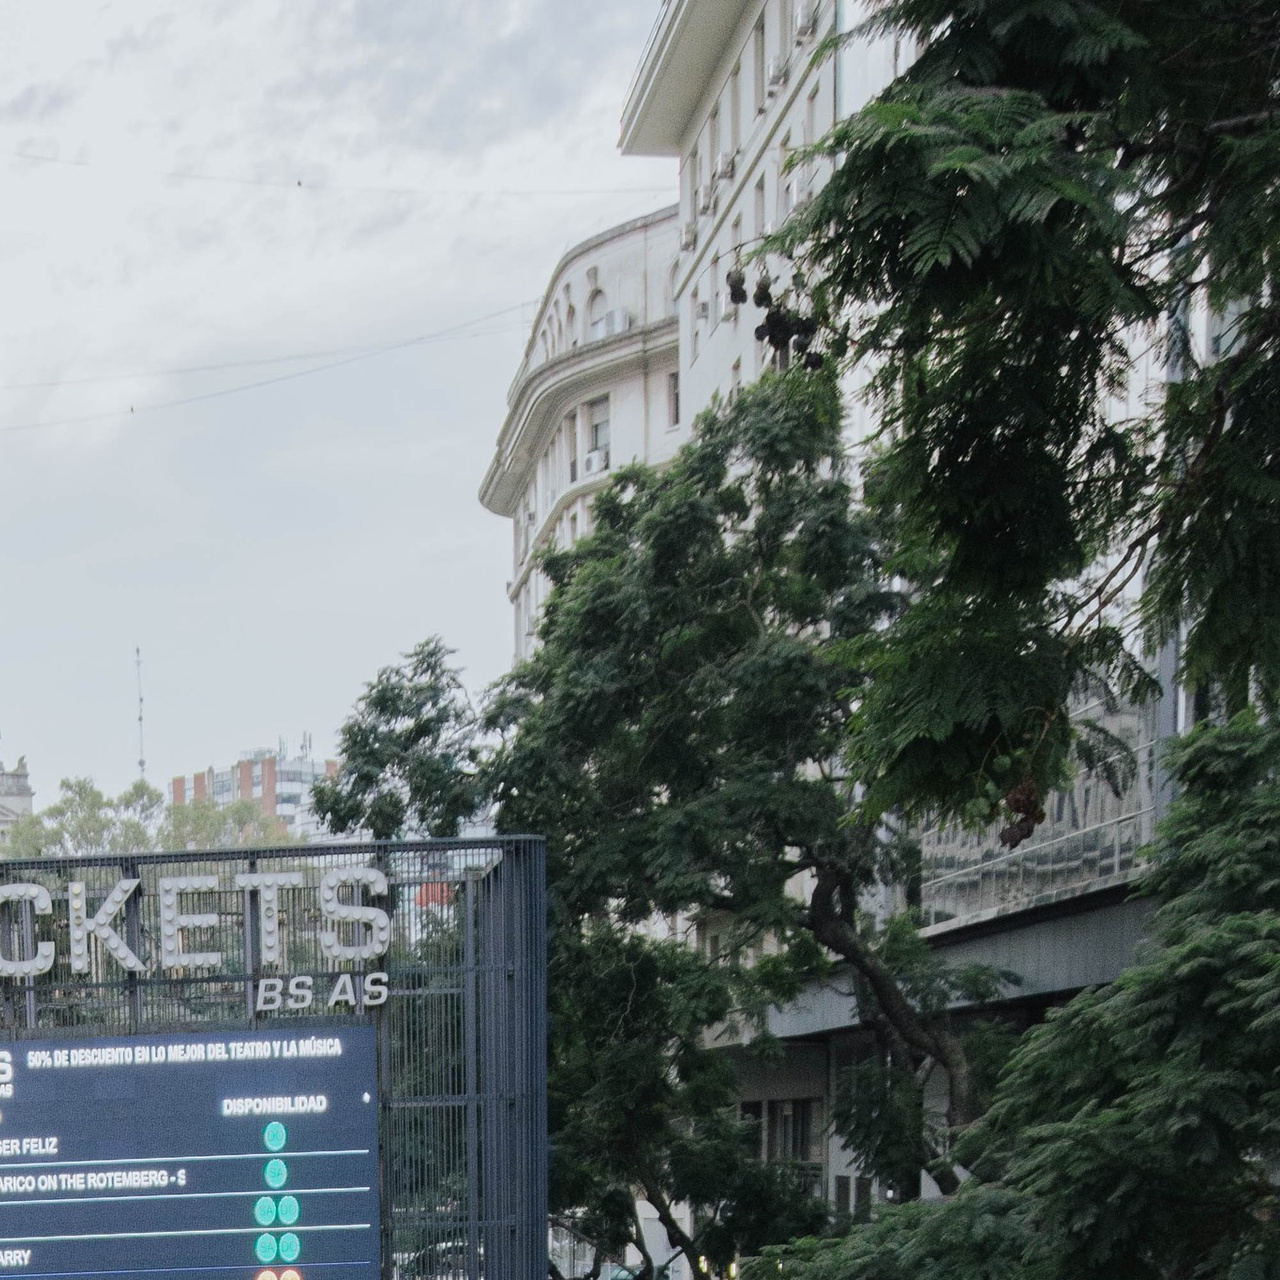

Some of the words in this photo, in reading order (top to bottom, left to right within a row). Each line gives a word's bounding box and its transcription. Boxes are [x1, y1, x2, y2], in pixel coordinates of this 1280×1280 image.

[256, 975, 314, 1011] BS
[327, 972, 389, 1006] AS
[27, 1051, 52, 1067] 50%
[54, 1050, 69, 1066] DE
[70, 1048, 133, 1066] DESCUENTO
[135, 1047, 150, 1064] EN
[151, 1046, 165, 1062] LO
[168, 1044, 205, 1062] MEJOR
[207, 1043, 228, 1060] DEL
[228, 1041, 270, 1059] TEATRO
[272, 1041, 280, 1057] Y
[282, 1040, 297, 1057] LA
[298, 1036, 342, 1057] MÚSICA
[222, 1095, 327, 1116] DISPONIBILIDAD
[22, 1137, 58, 1154] FELIZ
[38, 1175, 59, 1191] ON
[59, 1173, 85, 1190] THE
[87, 1170, 169, 1190] ROTEMBERG
